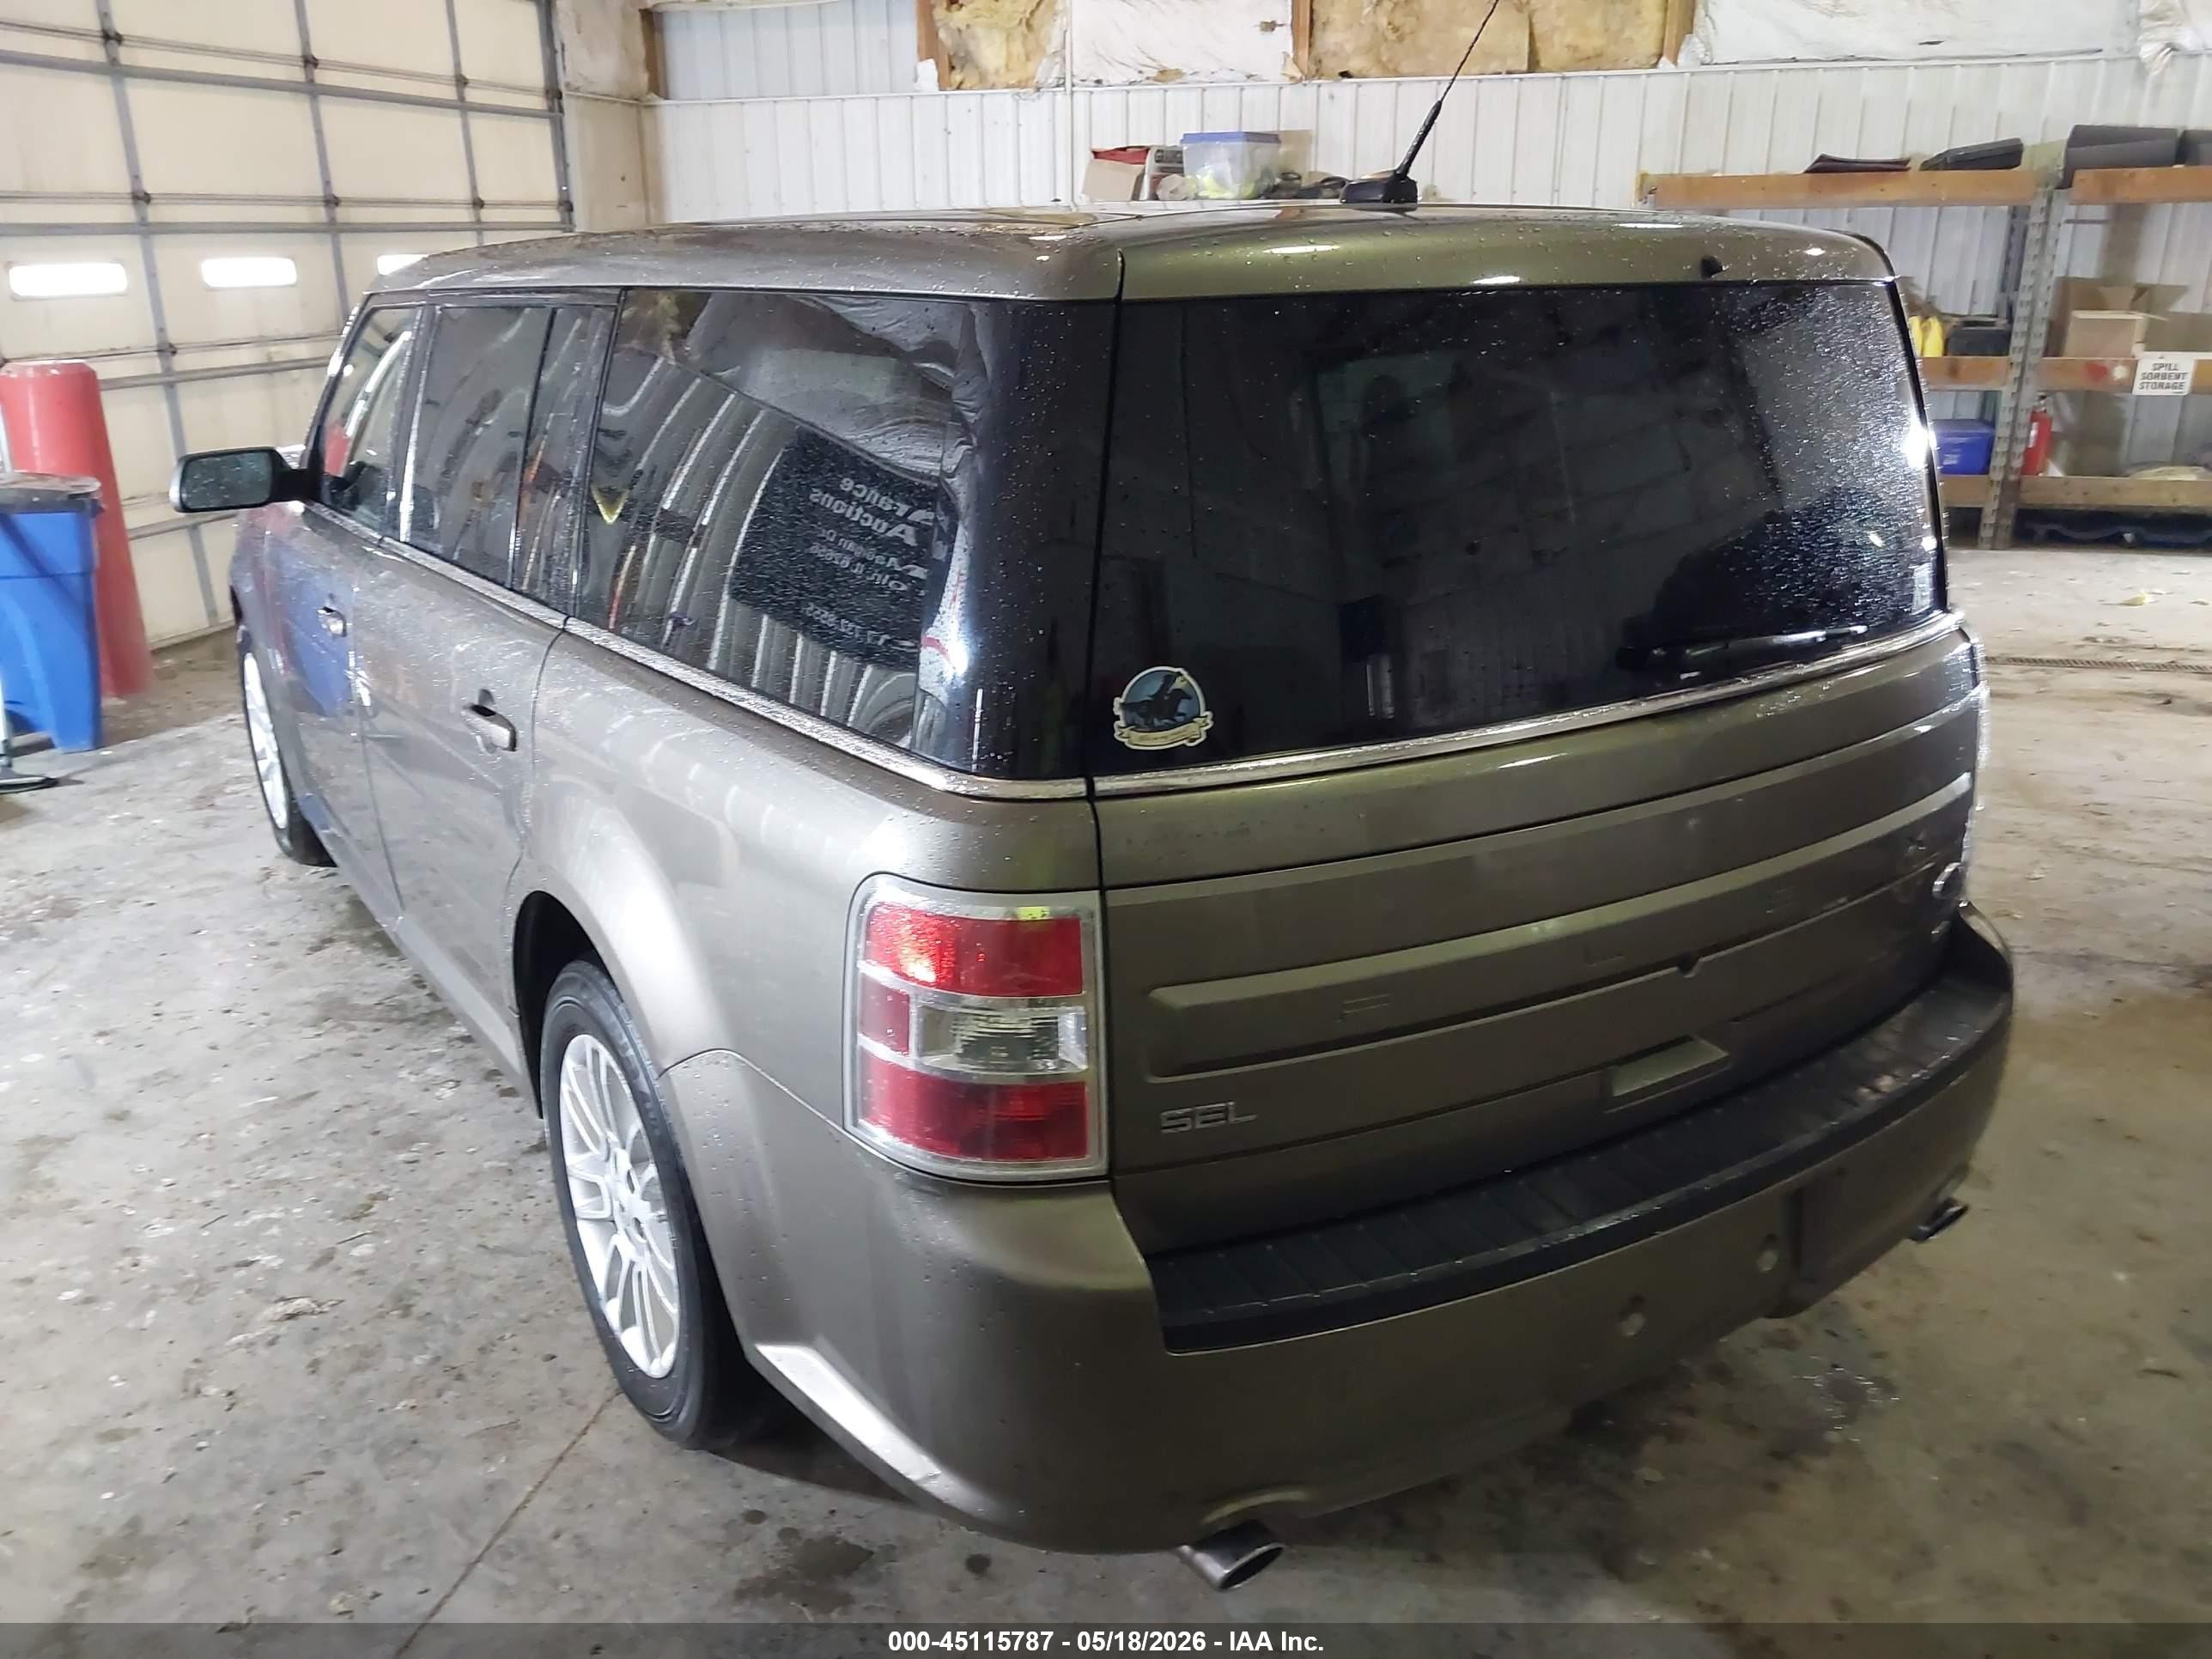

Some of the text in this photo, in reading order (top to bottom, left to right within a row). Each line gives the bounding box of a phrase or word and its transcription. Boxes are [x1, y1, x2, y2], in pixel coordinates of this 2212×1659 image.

[2152, 362, 2179, 372] SPILL
[2141, 372, 2188, 380] SORBENT
[2138, 381, 2185, 390] STORAGE
[1160, 1101, 1257, 1133] SEL
